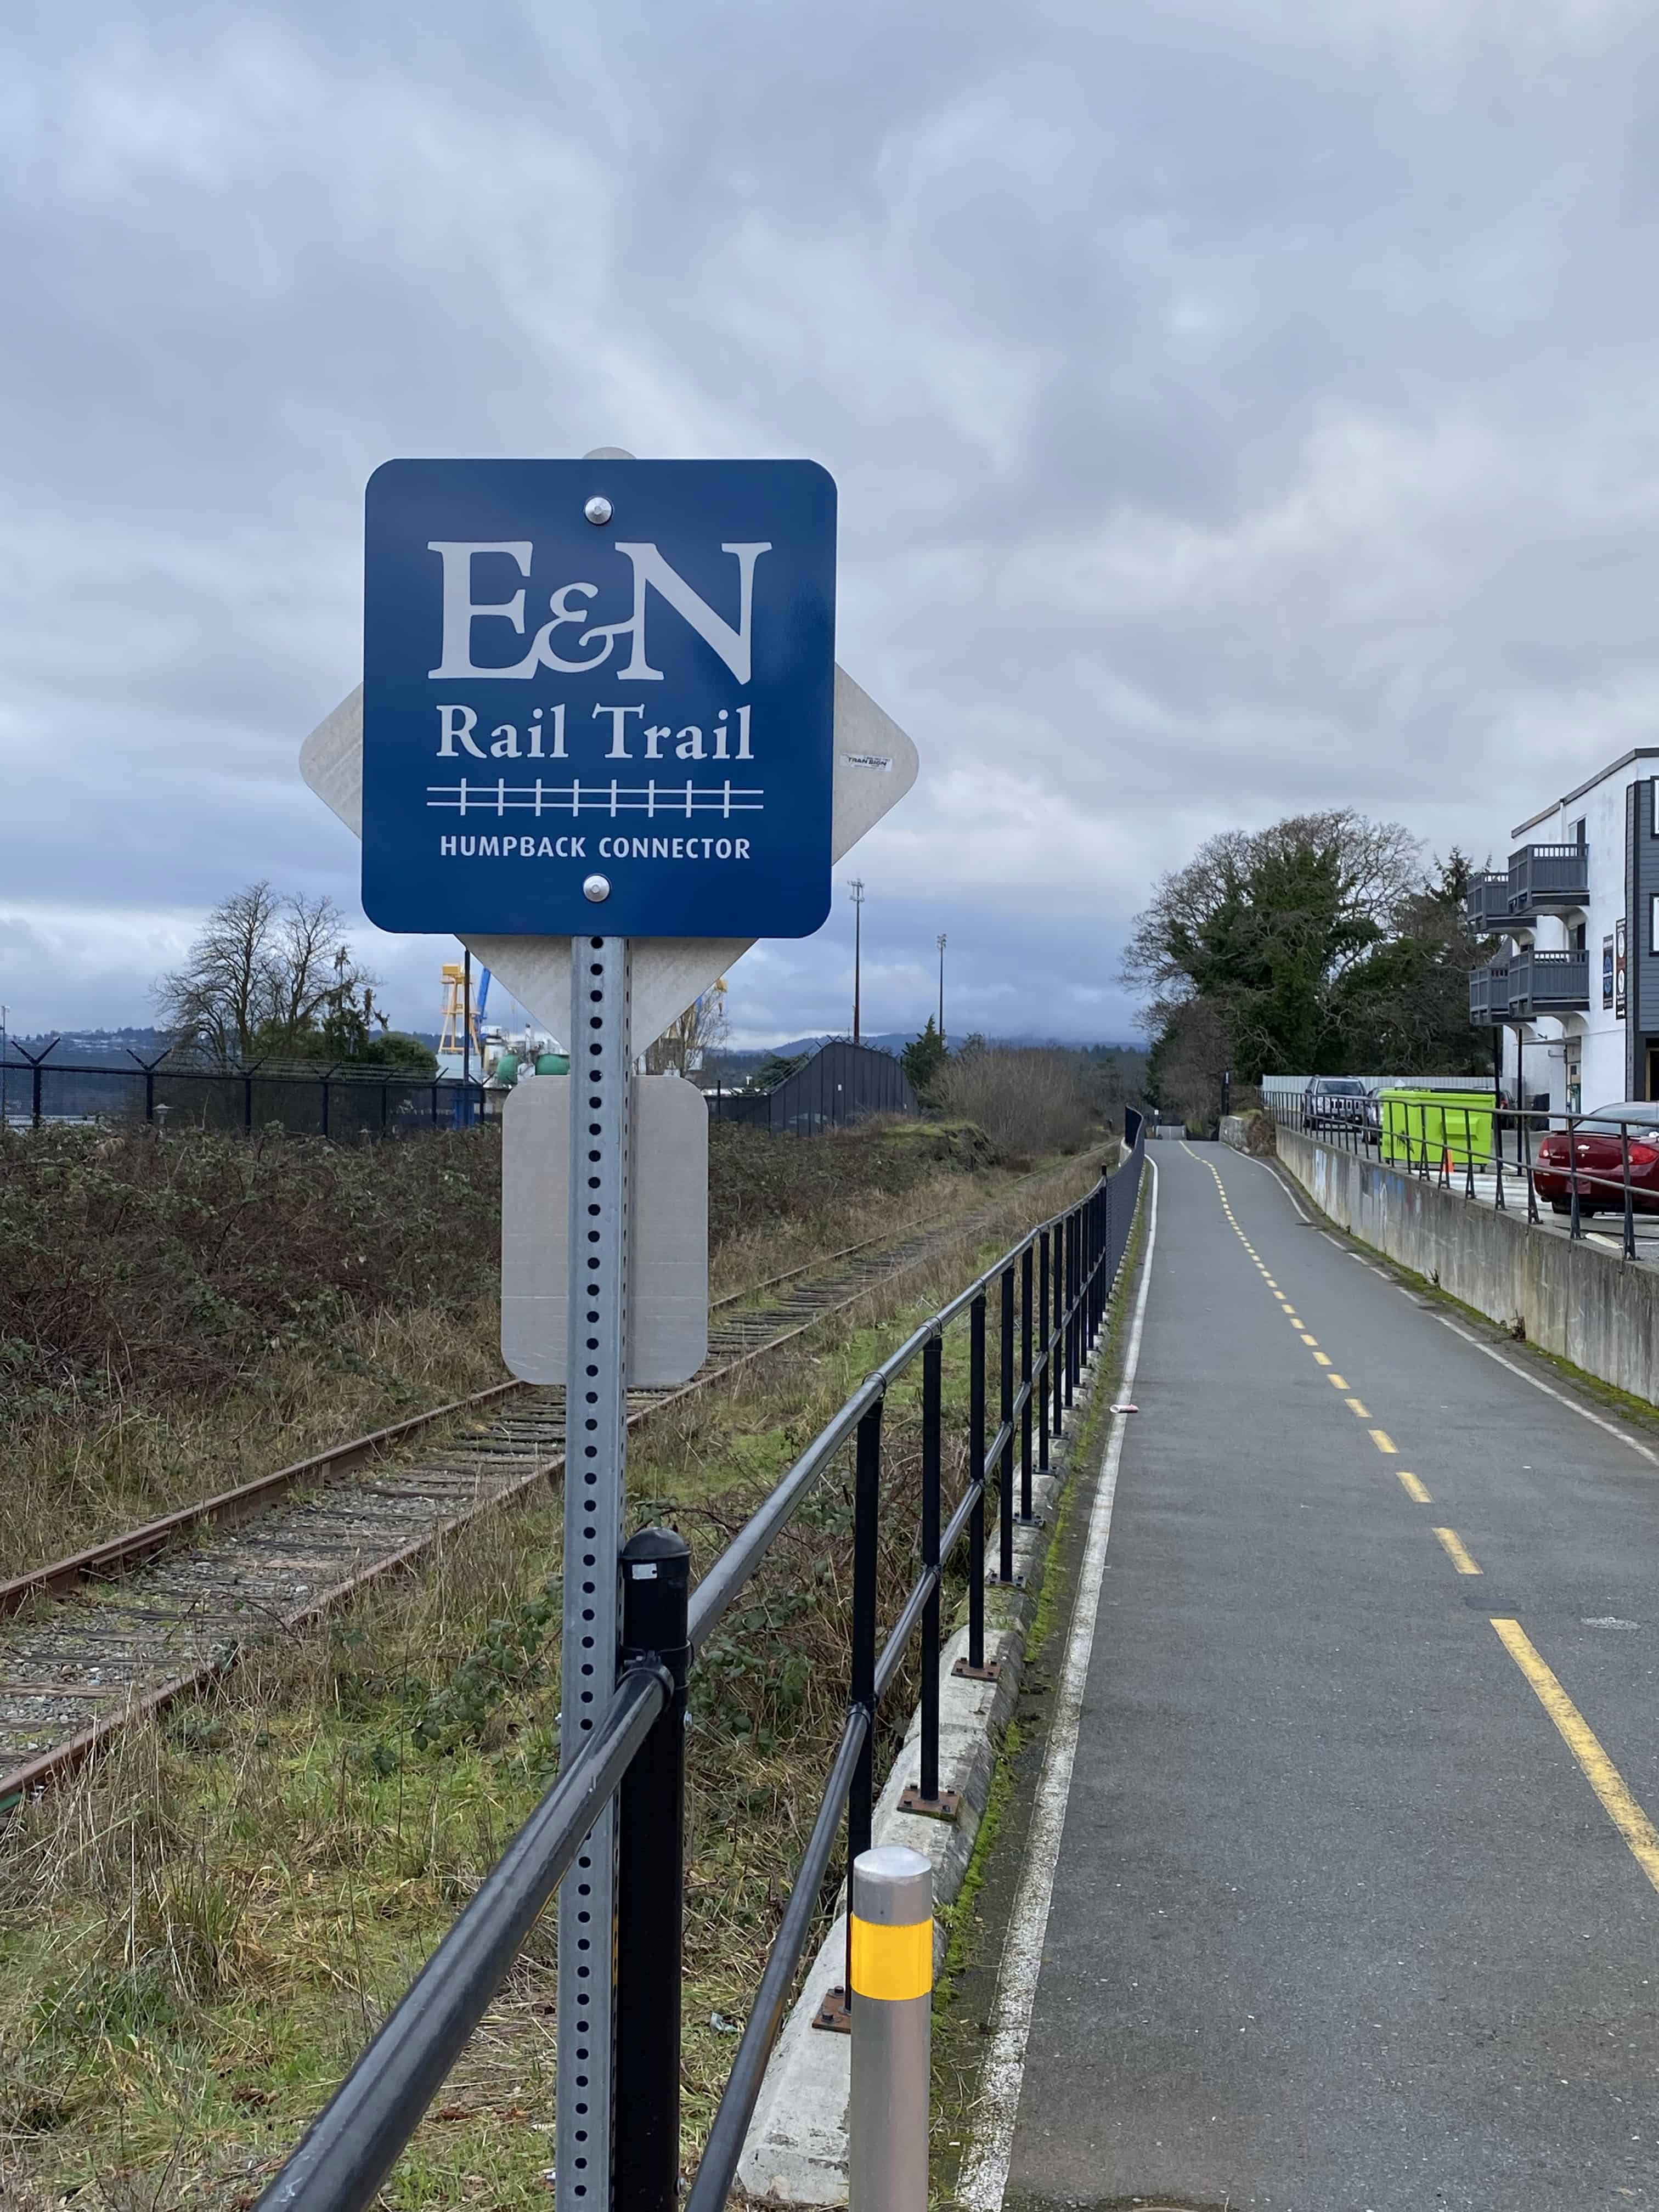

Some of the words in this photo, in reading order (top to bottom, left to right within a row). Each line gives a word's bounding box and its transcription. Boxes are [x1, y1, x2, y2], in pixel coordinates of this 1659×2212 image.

[427, 541, 772, 685] E&N
[436, 704, 569, 759] Rail
[591, 703, 754, 760] Trail
[441, 835, 586, 857] HUMPBACK
[599, 837, 750, 859] CONNECTOR
